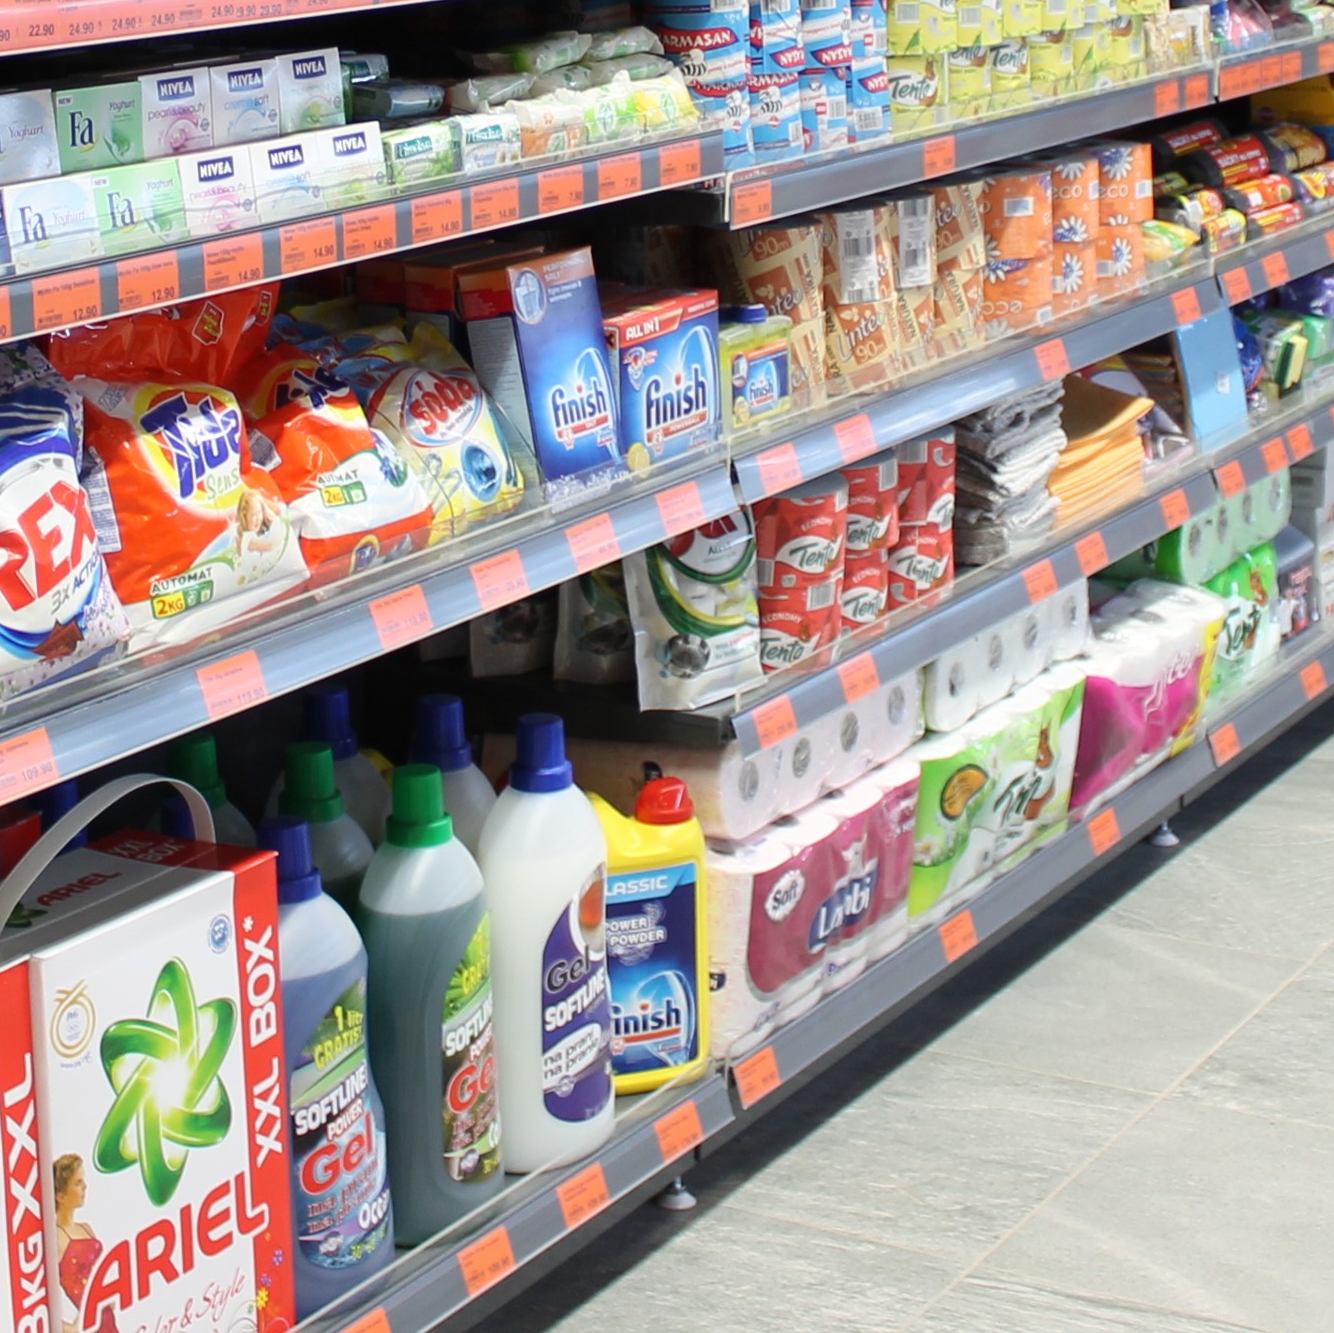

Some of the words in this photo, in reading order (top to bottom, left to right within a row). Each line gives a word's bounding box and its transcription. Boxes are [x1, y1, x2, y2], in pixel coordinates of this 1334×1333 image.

[28, 24, 55, 37] 22.90
[230, 71, 262, 88] NIVEA
[294, 60, 325, 76] NIVEA
[889, 76, 930, 102] Tento
[68, 110, 95, 149] Fa
[200, 161, 232, 178] NIVEA
[313, 245, 335, 259] 14.90
[237, 266, 261, 282] 14.90
[646, 364, 707, 431] finish
[749, 379, 774, 401] finish
[552, 381, 607, 428] finish
[801, 517, 834, 532] ECONOMY
[790, 541, 835, 568] Tento
[151, 567, 213, 594] AUTOMAT
[853, 568, 880, 583] ECONOMY
[157, 596, 184, 616] 2KG
[760, 637, 805, 662] Tento
[771, 881, 801, 915] Soft
[610, 926, 666, 948] POWDER
[545, 949, 591, 994] Gel
[248, 925, 277, 1047] BOX
[254, 1056, 284, 1168] XXL
[295, 1070, 367, 1136] SOFTLINE
[327, 1098, 363, 1141] POWER
[4, 1053, 43, 1236] XXL
[299, 1111, 375, 1196] Gel
[82, 1172, 269, 1333] ARIEL
